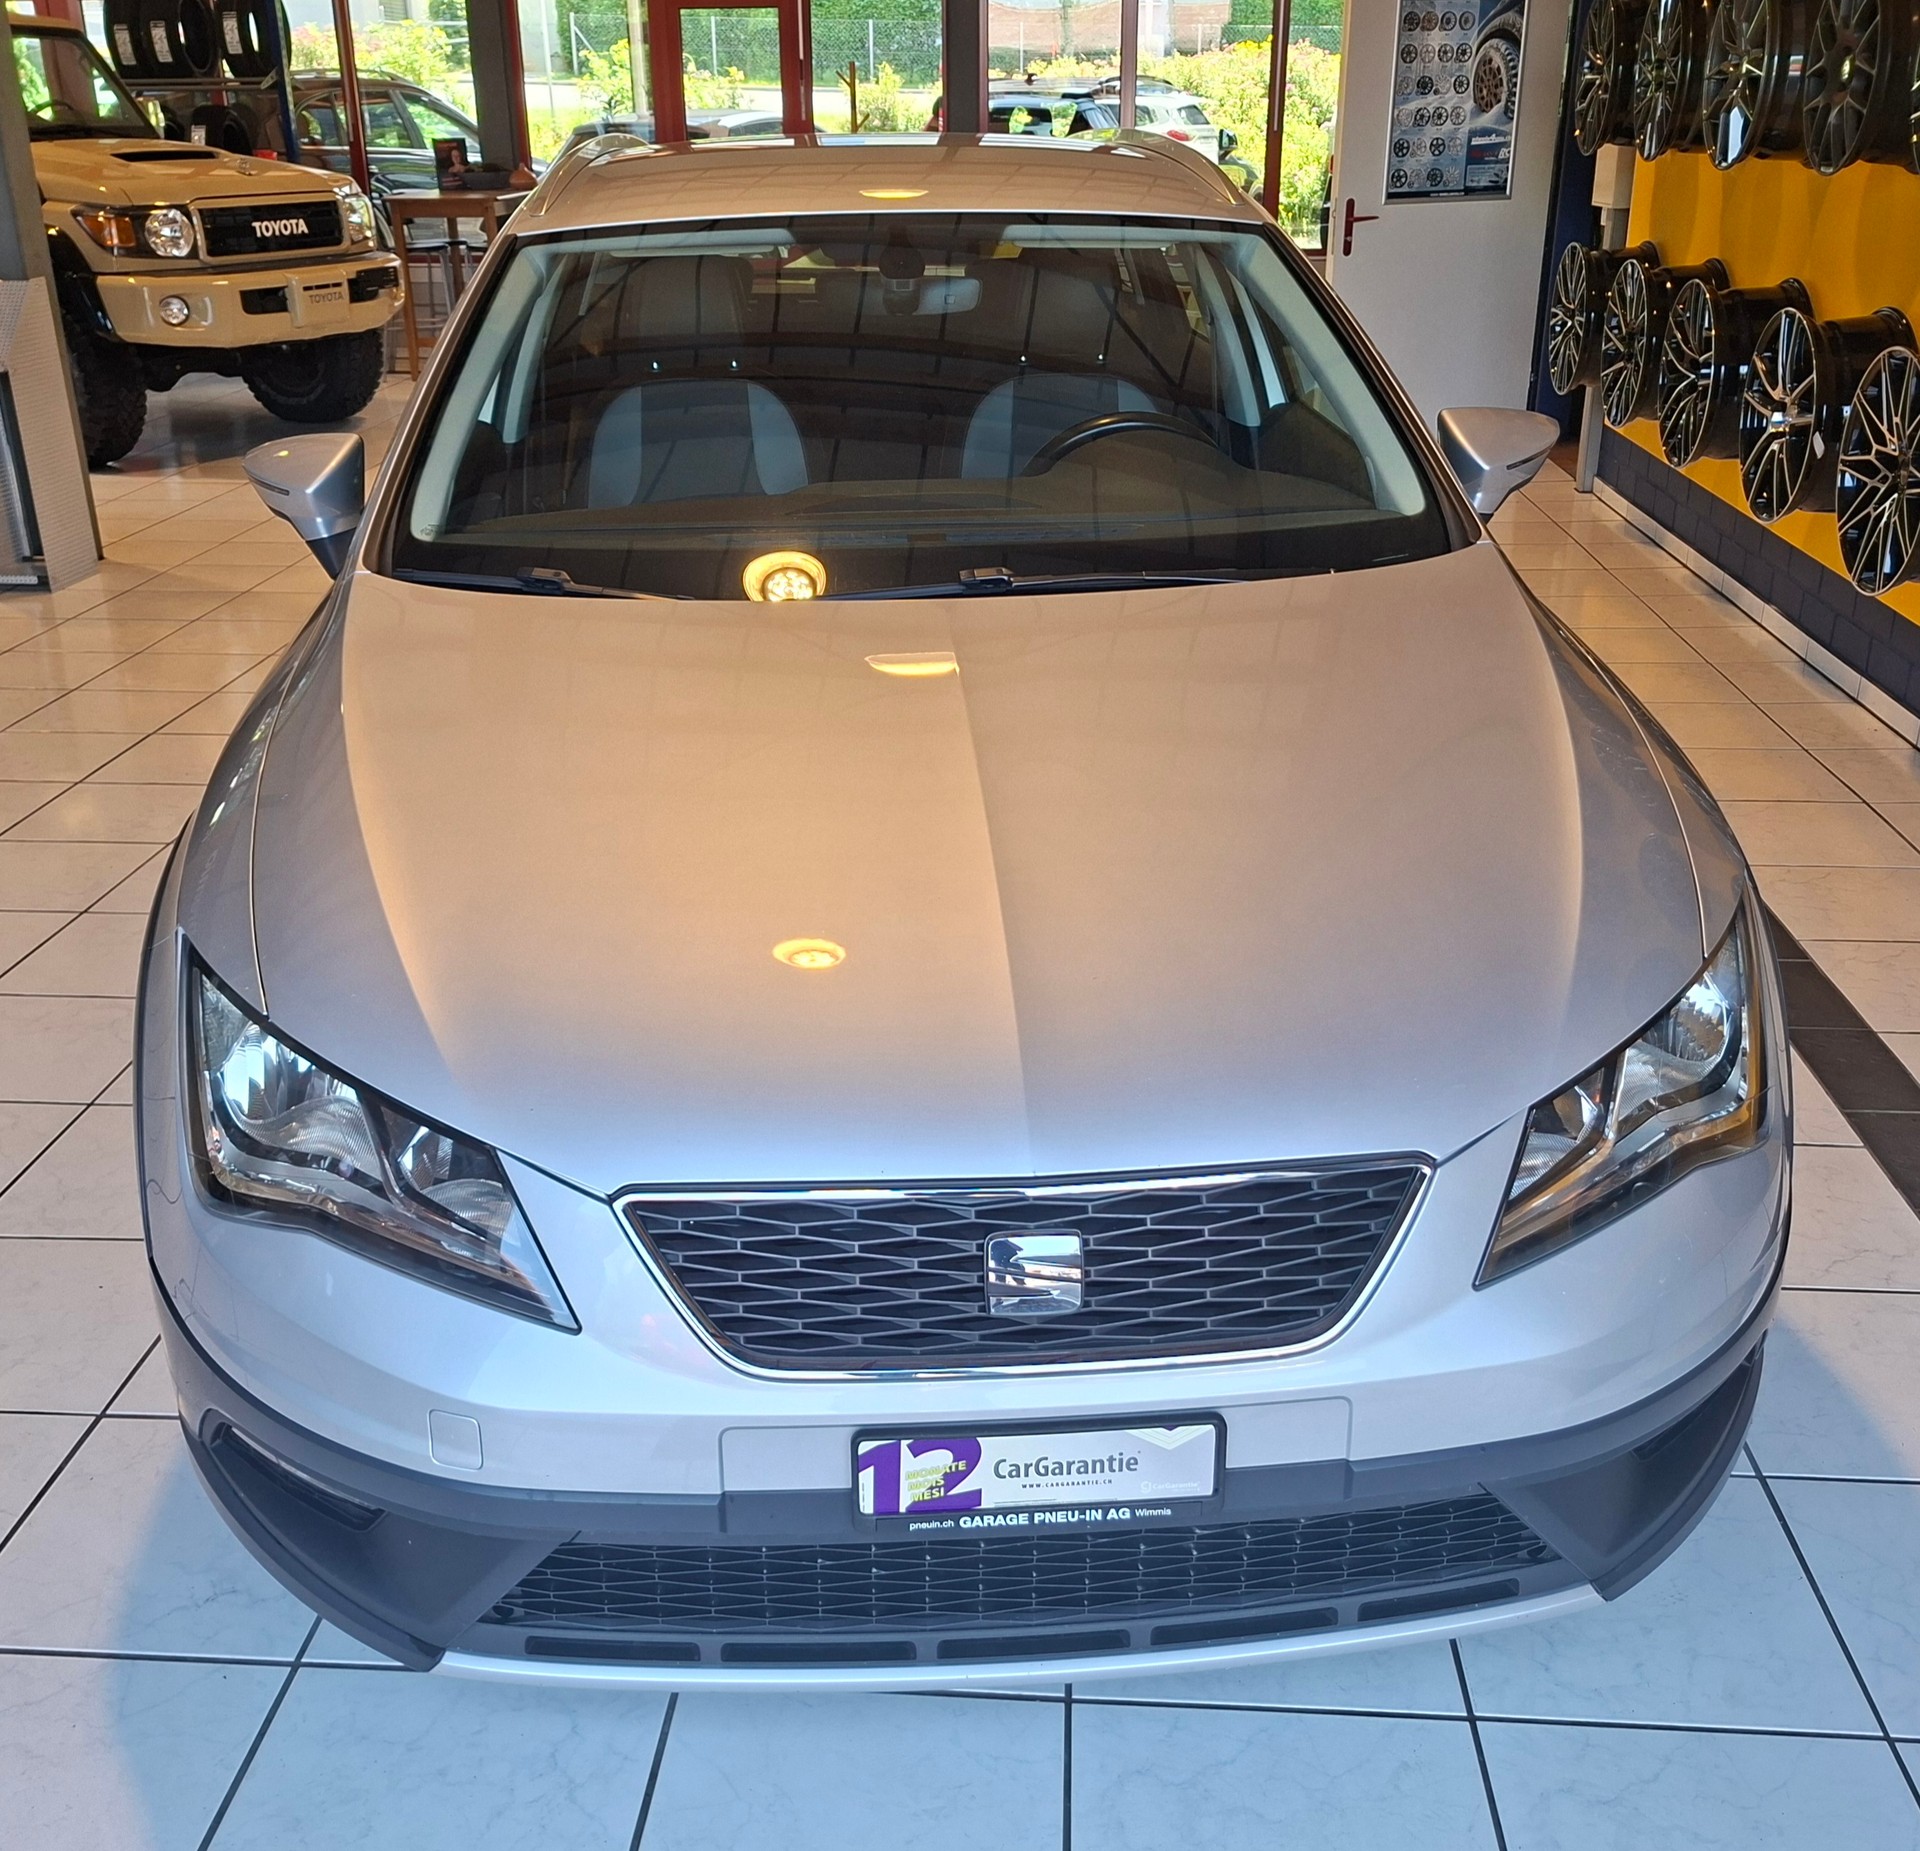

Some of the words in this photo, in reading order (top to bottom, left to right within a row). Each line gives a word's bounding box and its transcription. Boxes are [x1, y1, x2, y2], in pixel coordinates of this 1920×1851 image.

[251, 218, 309, 238] TOYOTA
[308, 291, 345, 304] TOYOTA
[905, 1460, 967, 1481] MONATE
[993, 1451, 1139, 1479] CarGarantie
[858, 1437, 982, 1515] 12
[907, 1475, 945, 1492] MOIS
[1021, 1478, 1113, 1489] WWW.CARGARANTIE.CH
[910, 1486, 945, 1502] MESI
[909, 1518, 955, 1531] pneuin.ch
[959, 1511, 1030, 1528] GARAGE
[1033, 1508, 1102, 1525] PNEU-IN
[1106, 1507, 1131, 1520] AG
[1134, 1507, 1172, 1518] Wimmis
